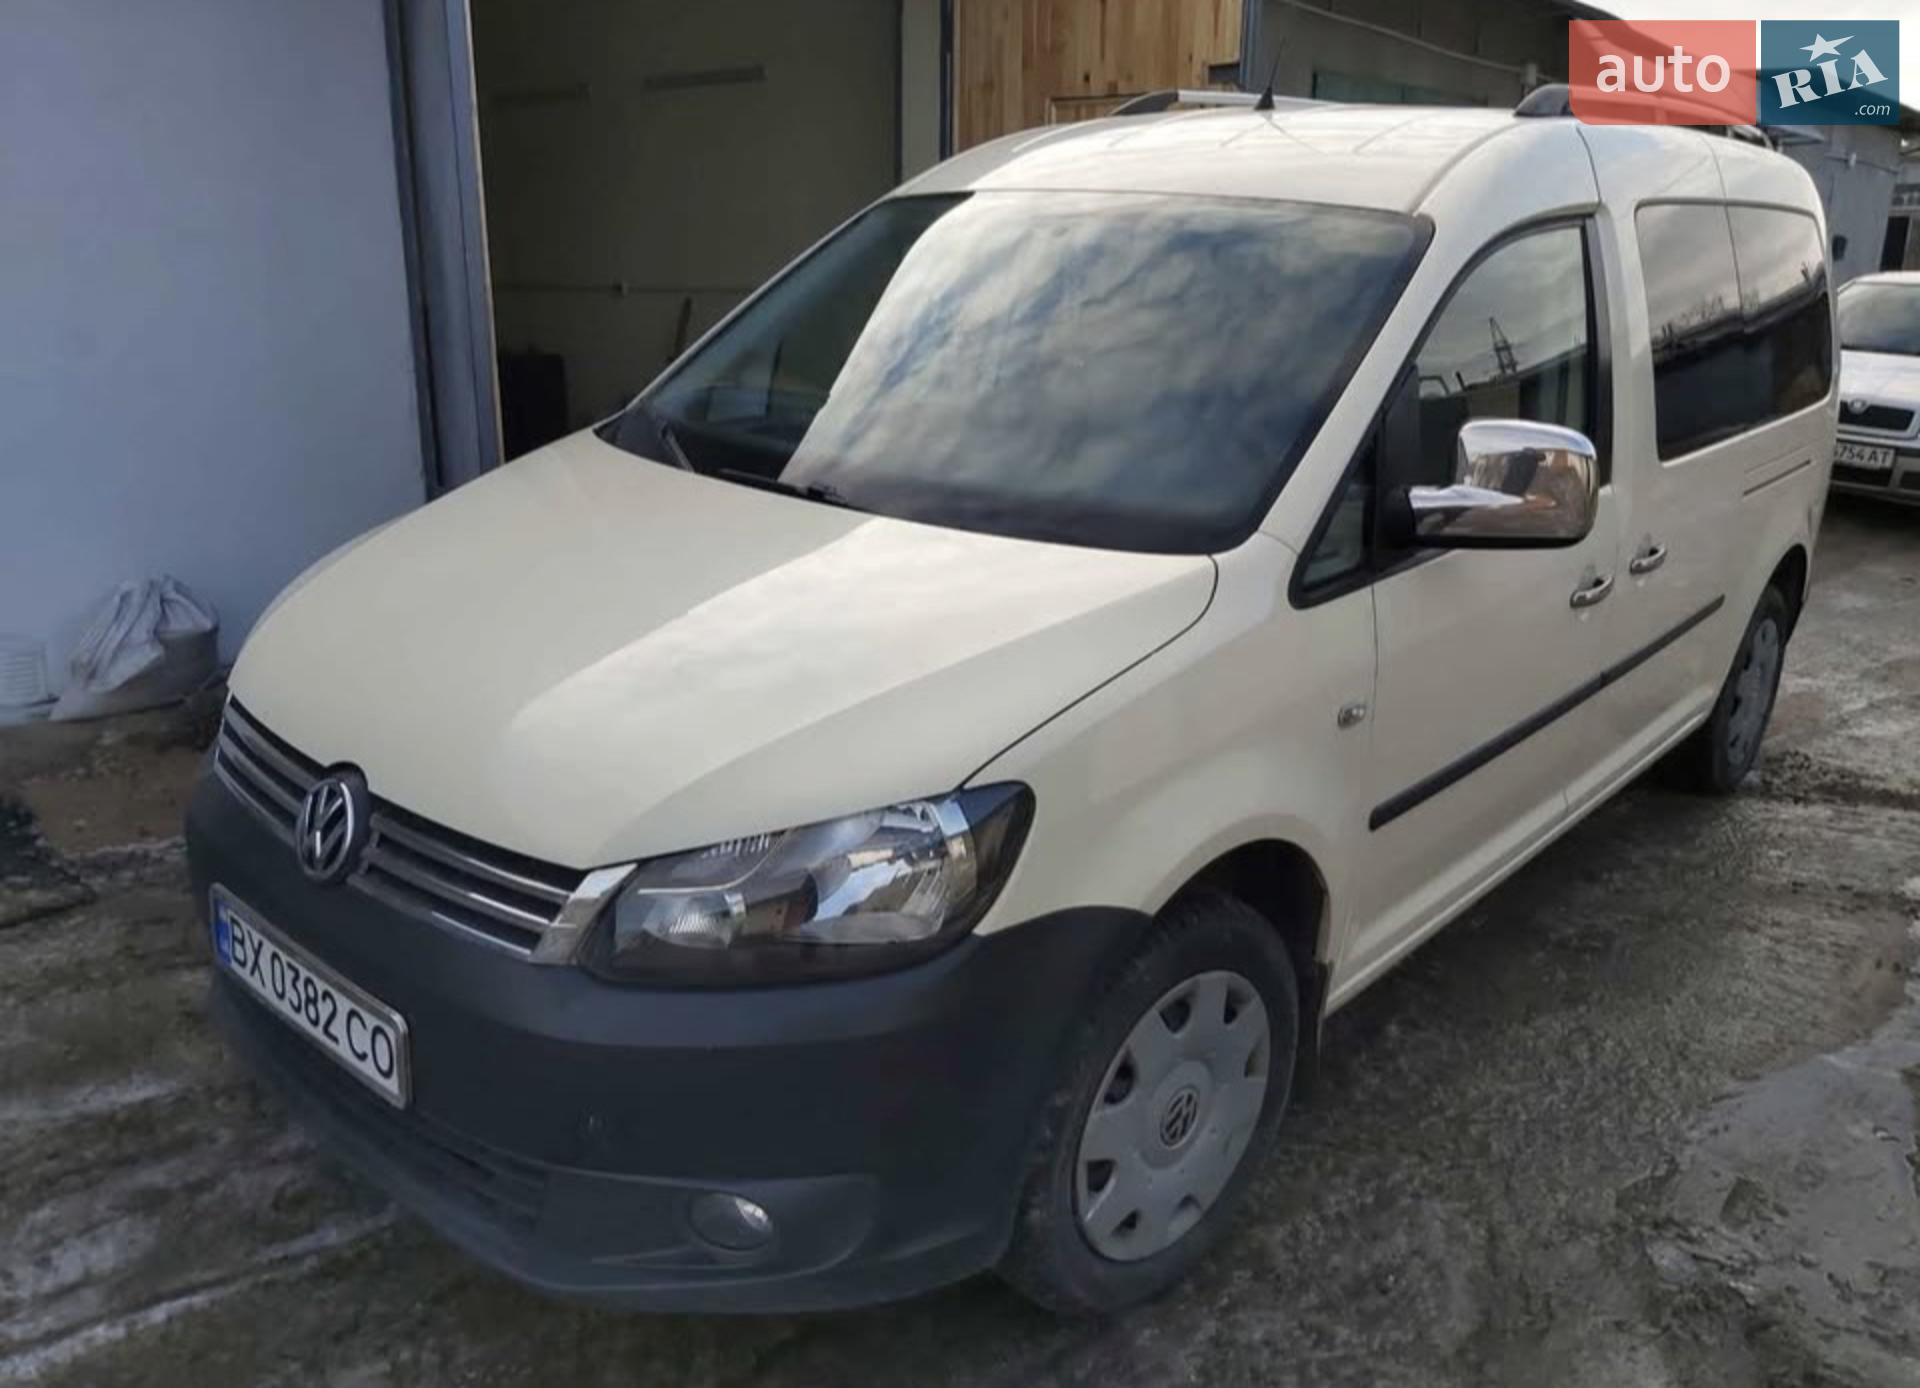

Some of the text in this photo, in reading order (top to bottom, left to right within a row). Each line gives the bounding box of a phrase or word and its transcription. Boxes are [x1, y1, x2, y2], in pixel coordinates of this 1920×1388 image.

[1867, 449, 1890, 465] AT
[229, 914, 395, 1080] BX 0382 CO
